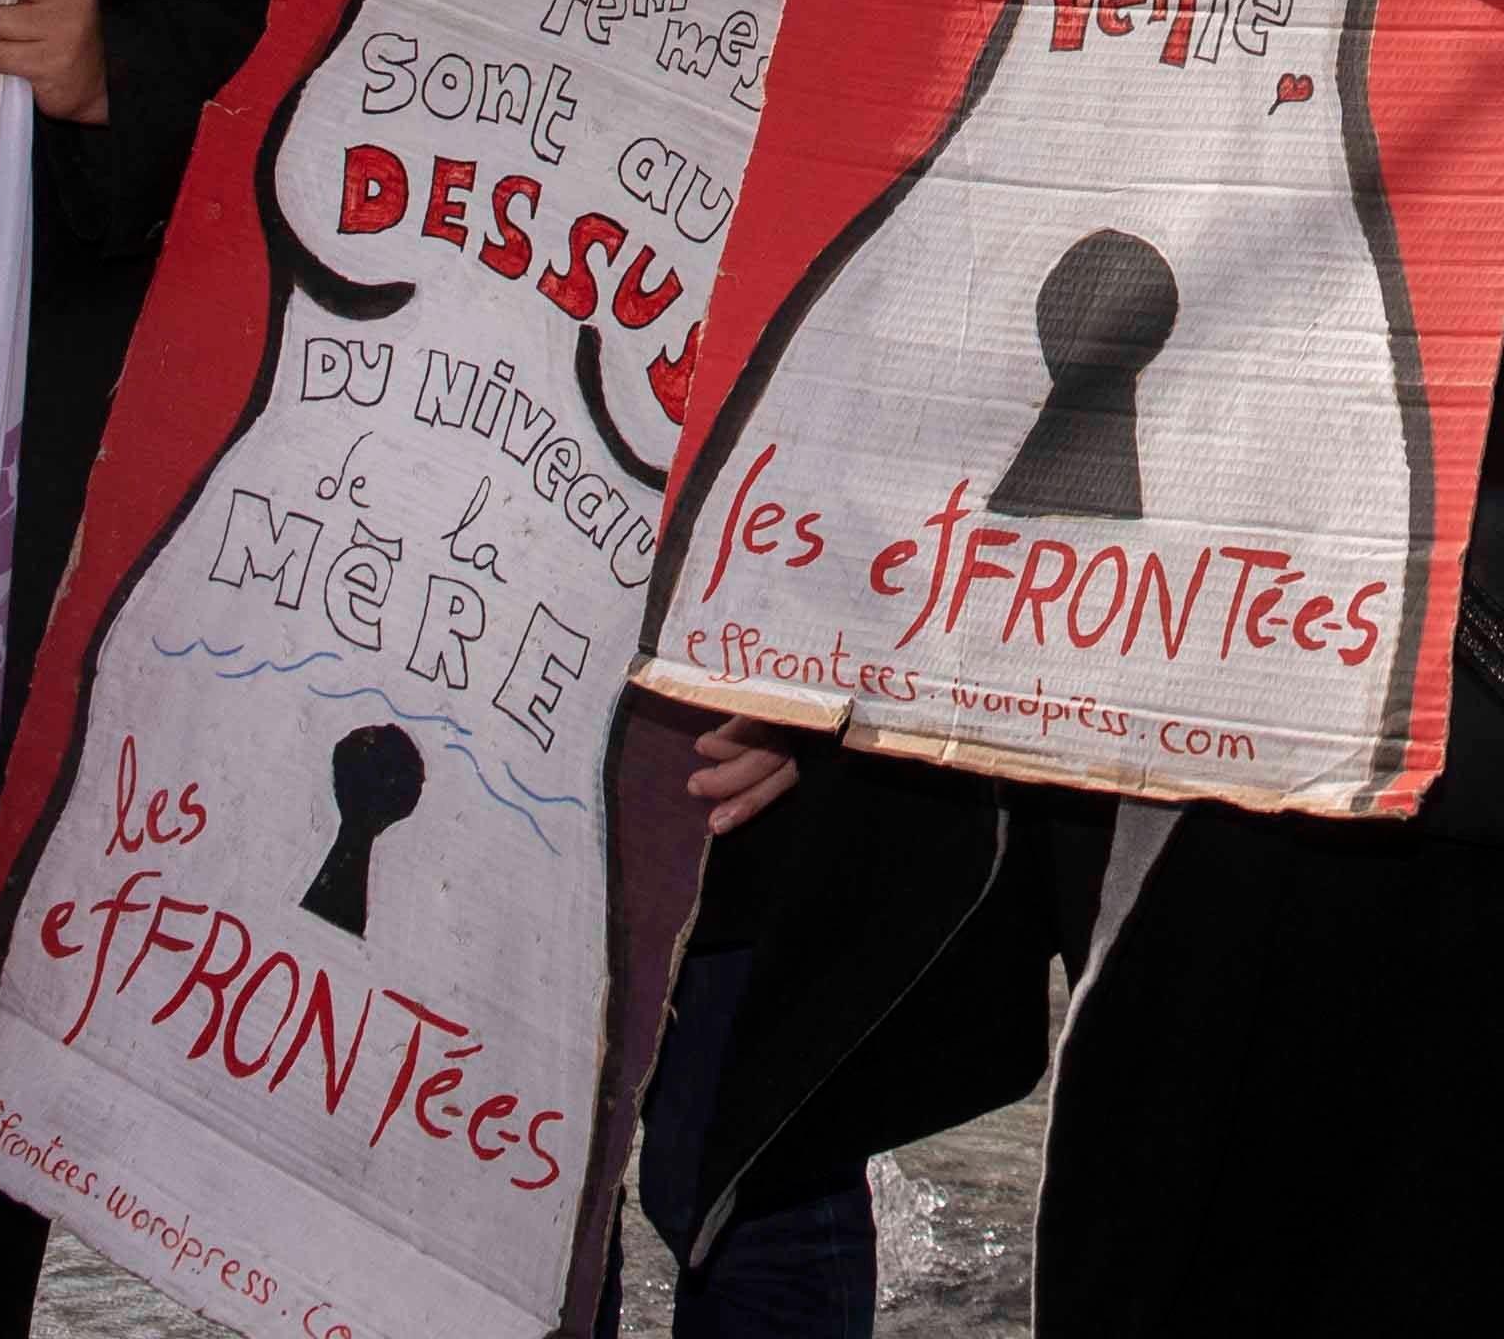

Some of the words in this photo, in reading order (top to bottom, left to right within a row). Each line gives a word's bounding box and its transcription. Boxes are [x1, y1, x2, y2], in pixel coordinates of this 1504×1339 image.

[617, 136, 735, 244] au
[299, 336, 394, 407] DU
[413, 347, 657, 589] Niveau
[313, 431, 375, 510] de
[439, 475, 507, 584] la
[702, 442, 826, 606] les
[104, 734, 208, 856] les
